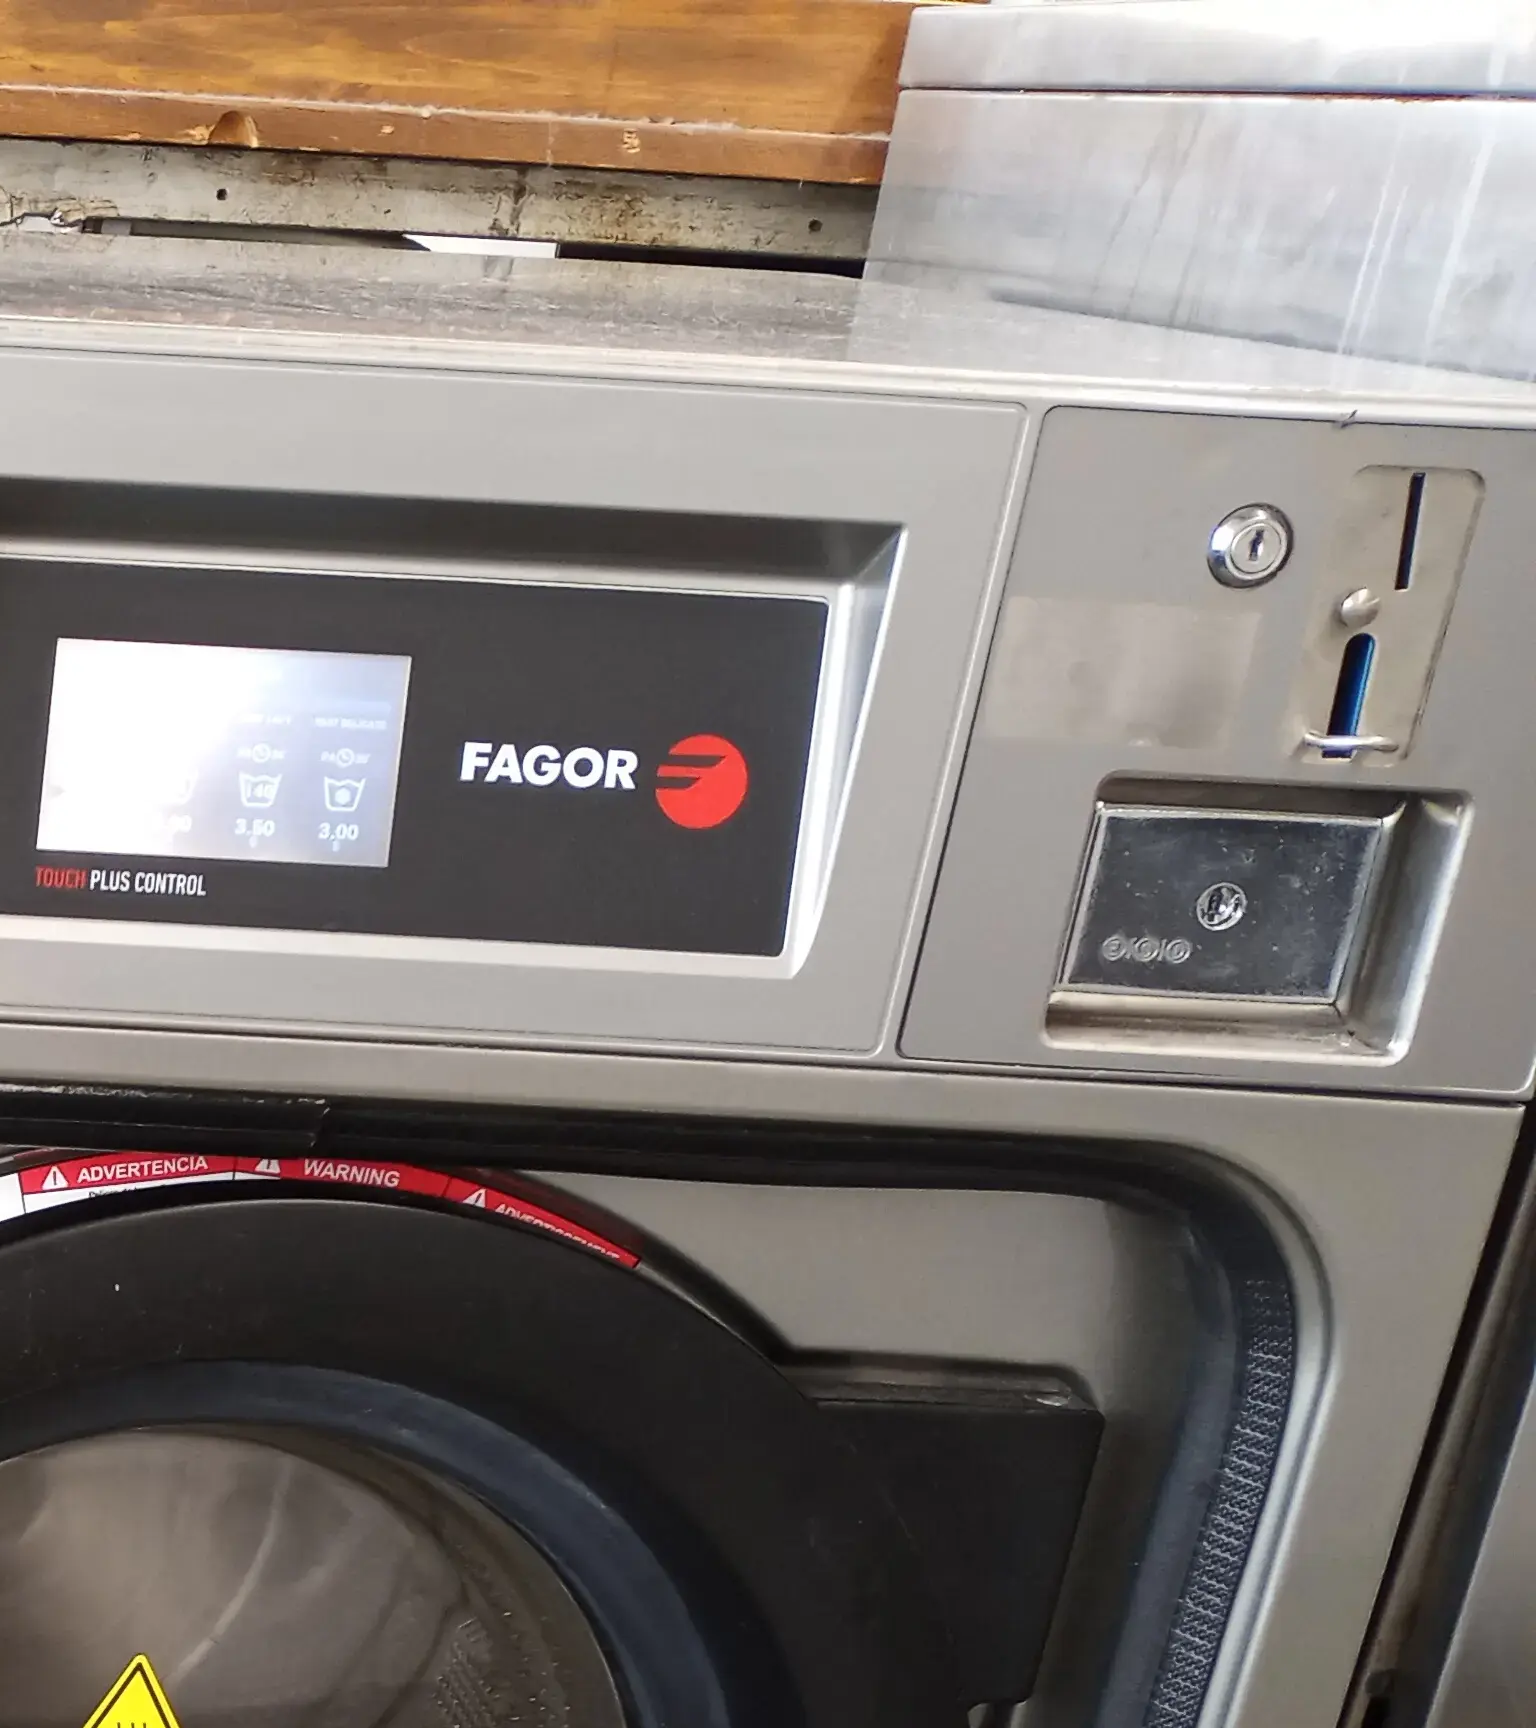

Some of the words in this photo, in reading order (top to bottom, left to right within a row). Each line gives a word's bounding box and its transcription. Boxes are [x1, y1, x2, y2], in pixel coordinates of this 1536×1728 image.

[459, 742, 639, 790] FAGOR
[35, 866, 86, 889] TOUCH
[89, 870, 130, 892] PLUS
[134, 872, 207, 897] CONTROL
[77, 1156, 209, 1183] ADVERTENCIA
[304, 1159, 401, 1187] WARNING
